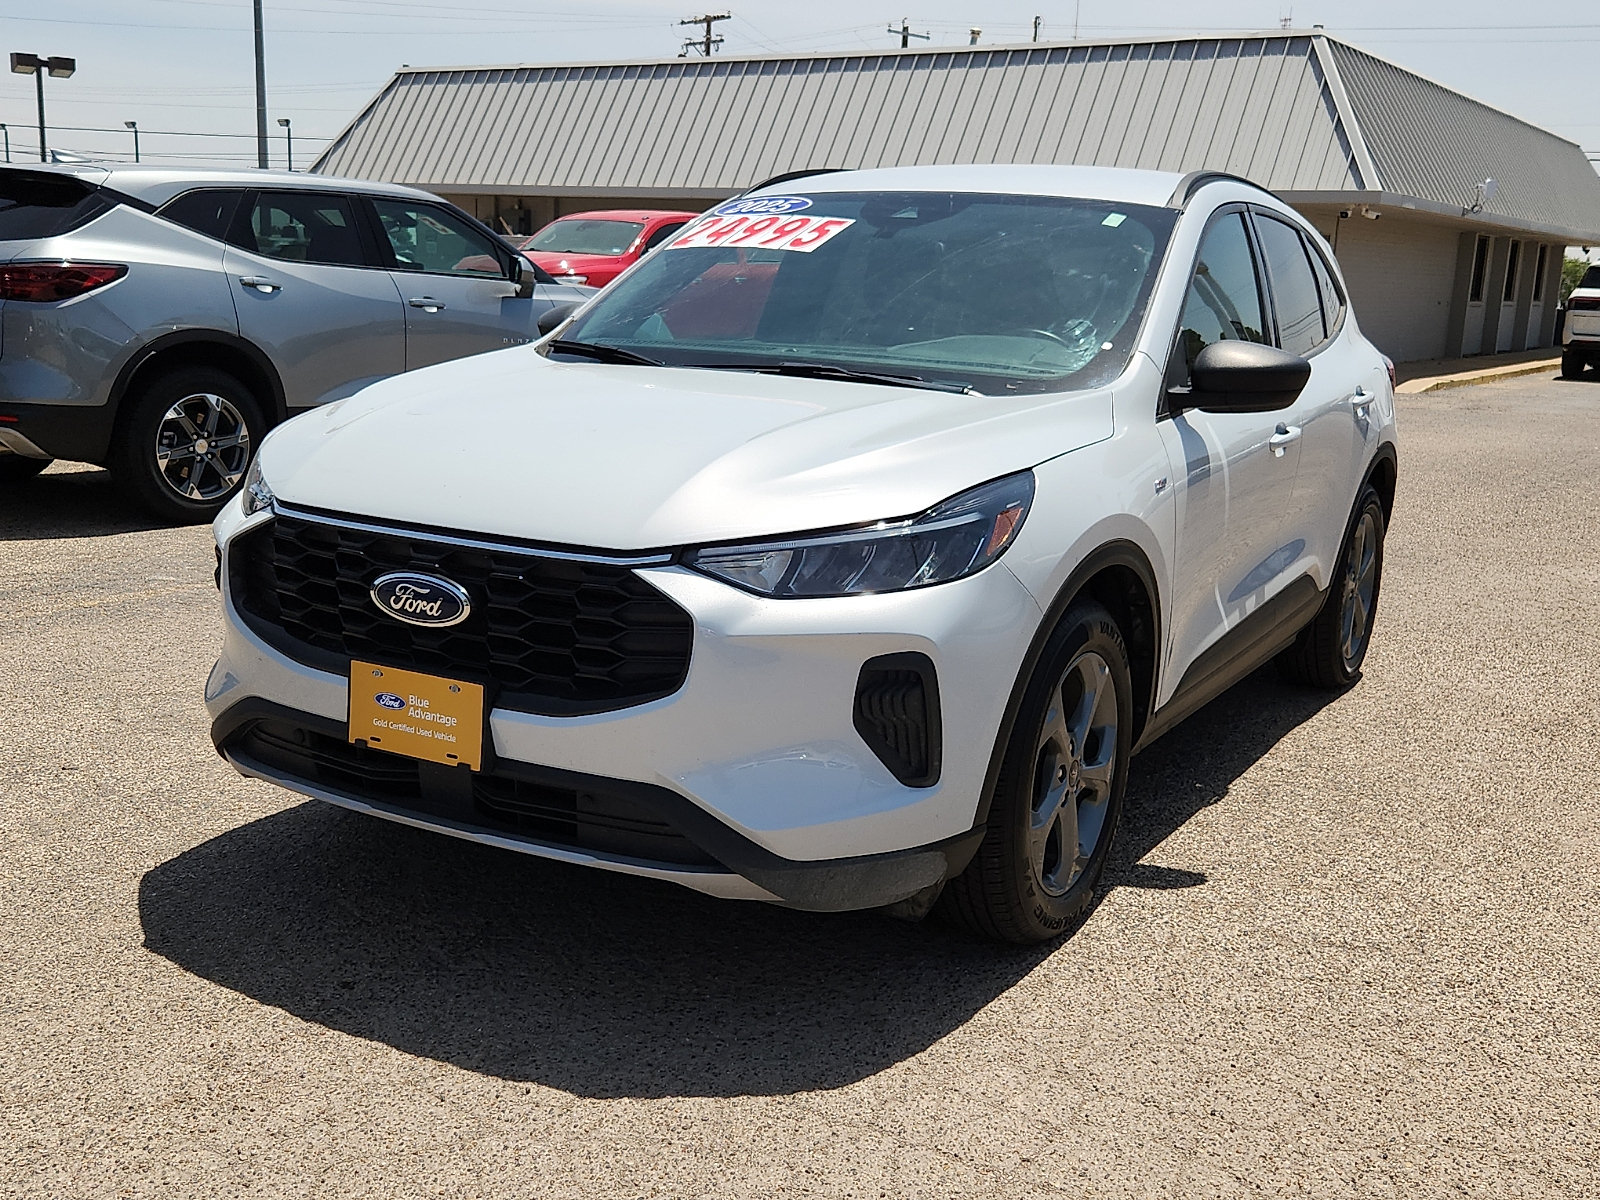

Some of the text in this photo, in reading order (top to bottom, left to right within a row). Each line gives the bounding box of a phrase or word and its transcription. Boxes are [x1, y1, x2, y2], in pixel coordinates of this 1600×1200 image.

[723, 199, 803, 214] 2025
[671, 216, 850, 248] 24995
[389, 583, 444, 617] Ford
[380, 694, 401, 708] Ford
[408, 694, 430, 709] Blue
[407, 706, 458, 727] Advantage
[372, 718, 457, 743] Gold Certified Used Vehicle
